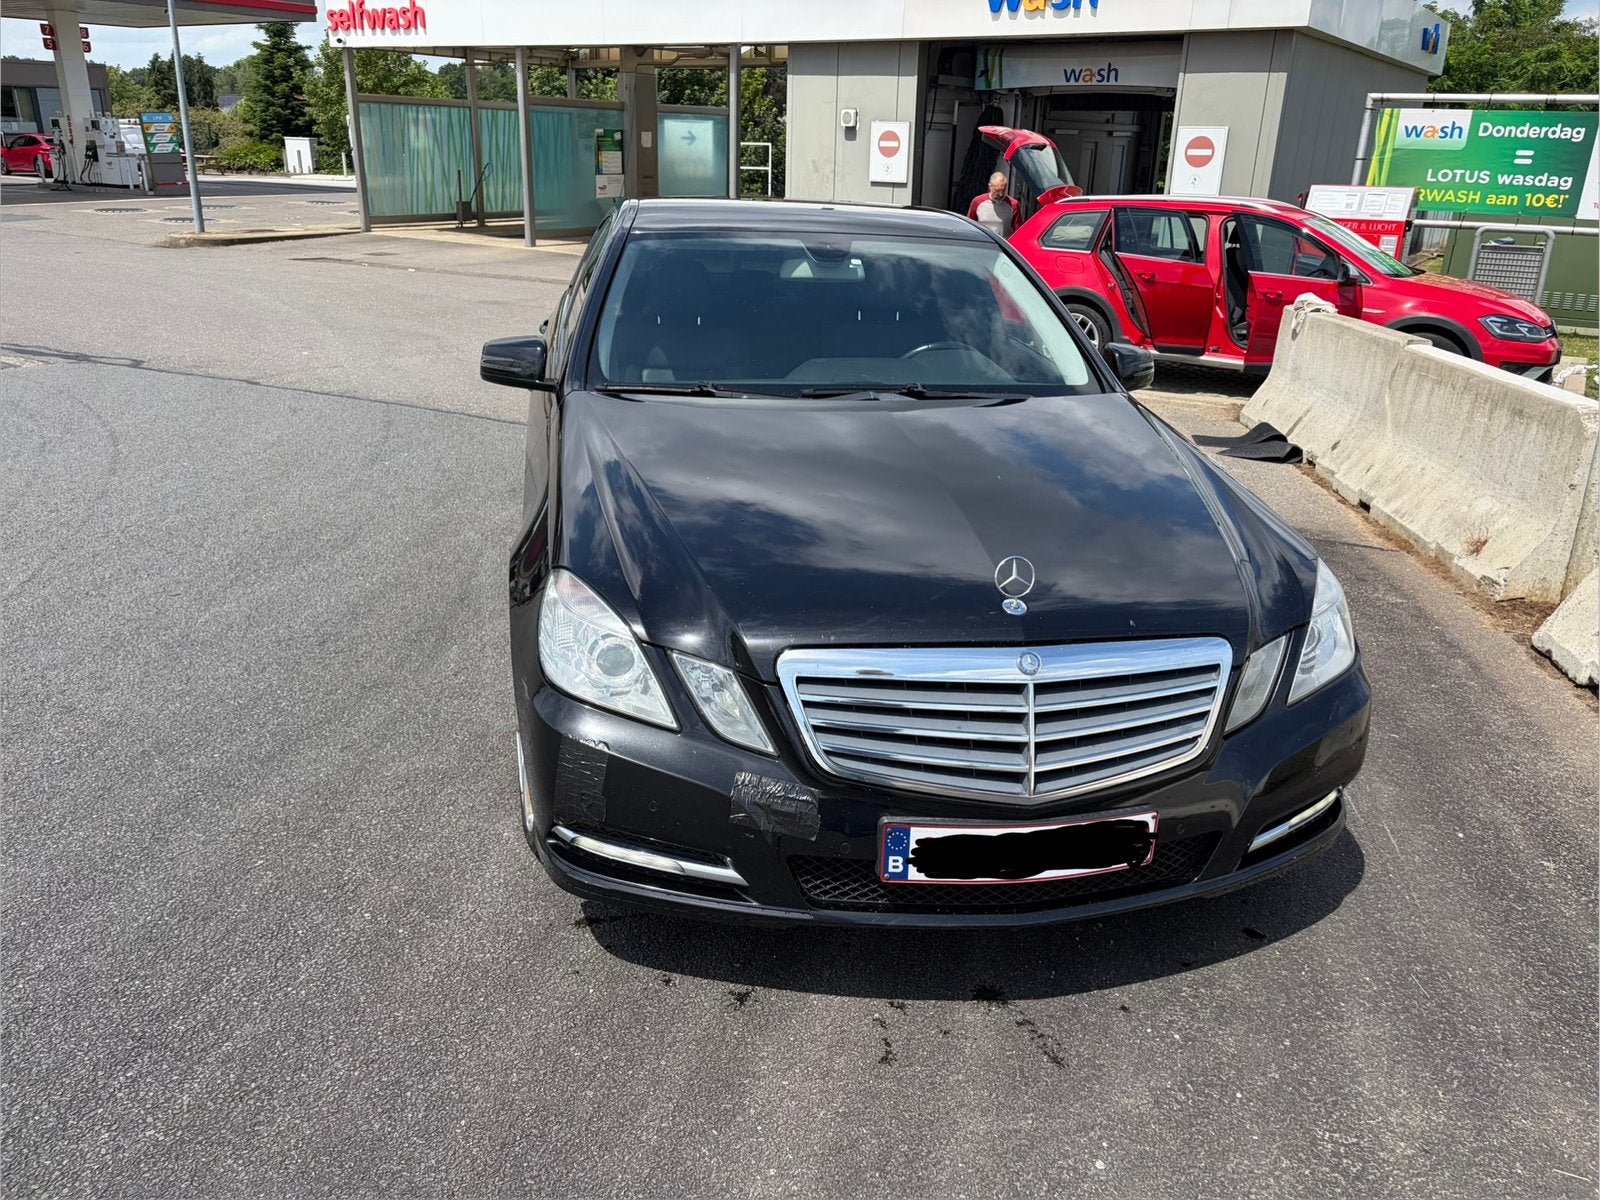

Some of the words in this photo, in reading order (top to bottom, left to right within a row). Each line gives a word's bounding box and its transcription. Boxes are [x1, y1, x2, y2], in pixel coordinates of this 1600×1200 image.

[327, 0, 427, 31] selfwash
[1063, 62, 1119, 83] wash
[1404, 121, 1464, 140] wash
[1478, 122, 1586, 143] Donderdag
[1426, 168, 1491, 184] LOTUS
[1497, 172, 1573, 190] wasdag
[1486, 193, 1518, 206] aan
[1368, 223, 1397, 231] LUCHT
[888, 855, 904, 873] B
